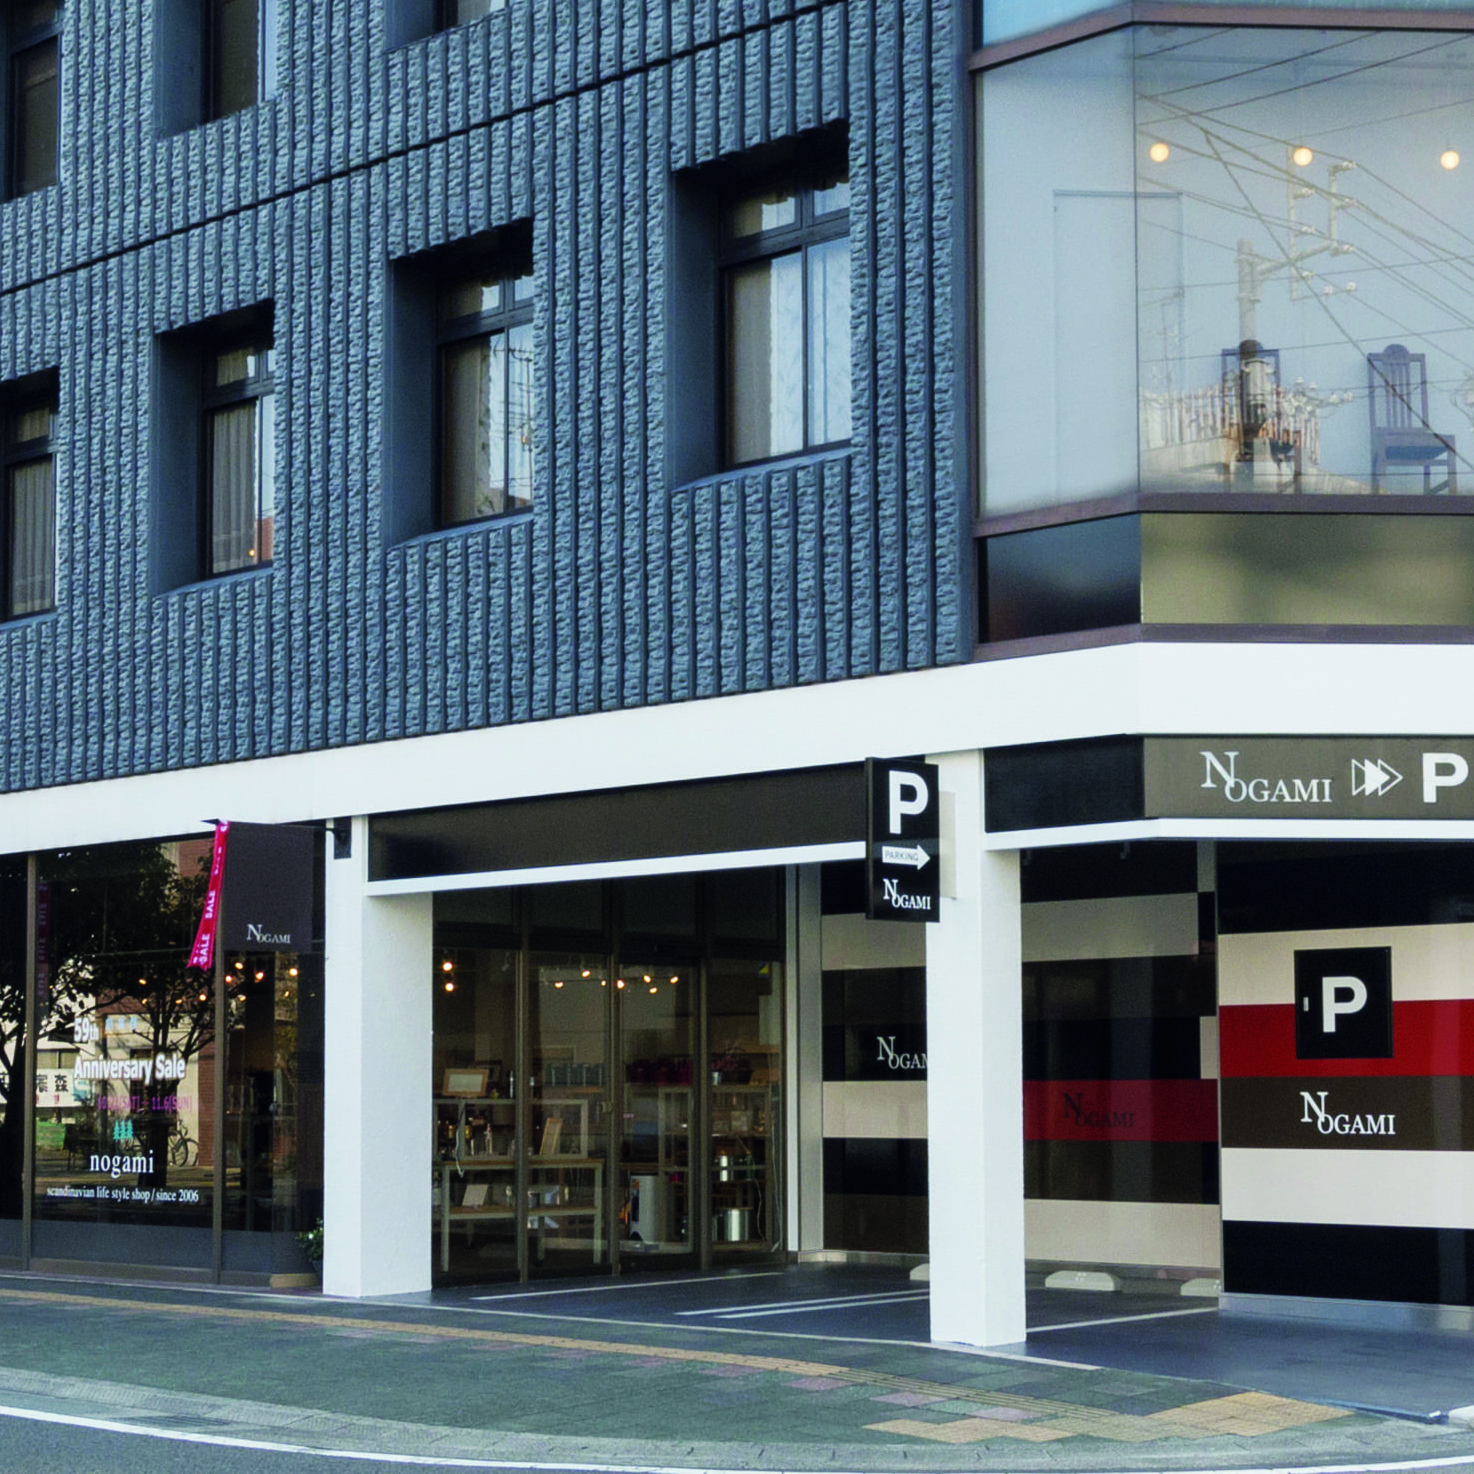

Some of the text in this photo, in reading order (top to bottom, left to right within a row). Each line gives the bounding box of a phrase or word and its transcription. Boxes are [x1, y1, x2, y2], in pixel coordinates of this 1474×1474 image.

[1200, 751, 1469, 803] NOGAMI P
[889, 770, 929, 834] P
[885, 850, 919, 862] PARKING
[204, 890, 216, 919] SALE
[883, 879, 931, 910] NOGAMI
[246, 924, 291, 944] NOGAMI
[1322, 976, 1368, 1033] P
[74, 1017, 99, 1042] 59th
[74, 1054, 186, 1086] Anniversary Sale
[1063, 1093, 1134, 1128] NOGAMI
[1299, 1091, 1396, 1135] NOGAMI
[90, 1150, 154, 1179] nogami
[47, 1185, 95, 1198] scandinavian
[96, 1186, 110, 1199] life
[111, 1187, 130, 1202] style
[178, 1189, 199, 1202] 2006
